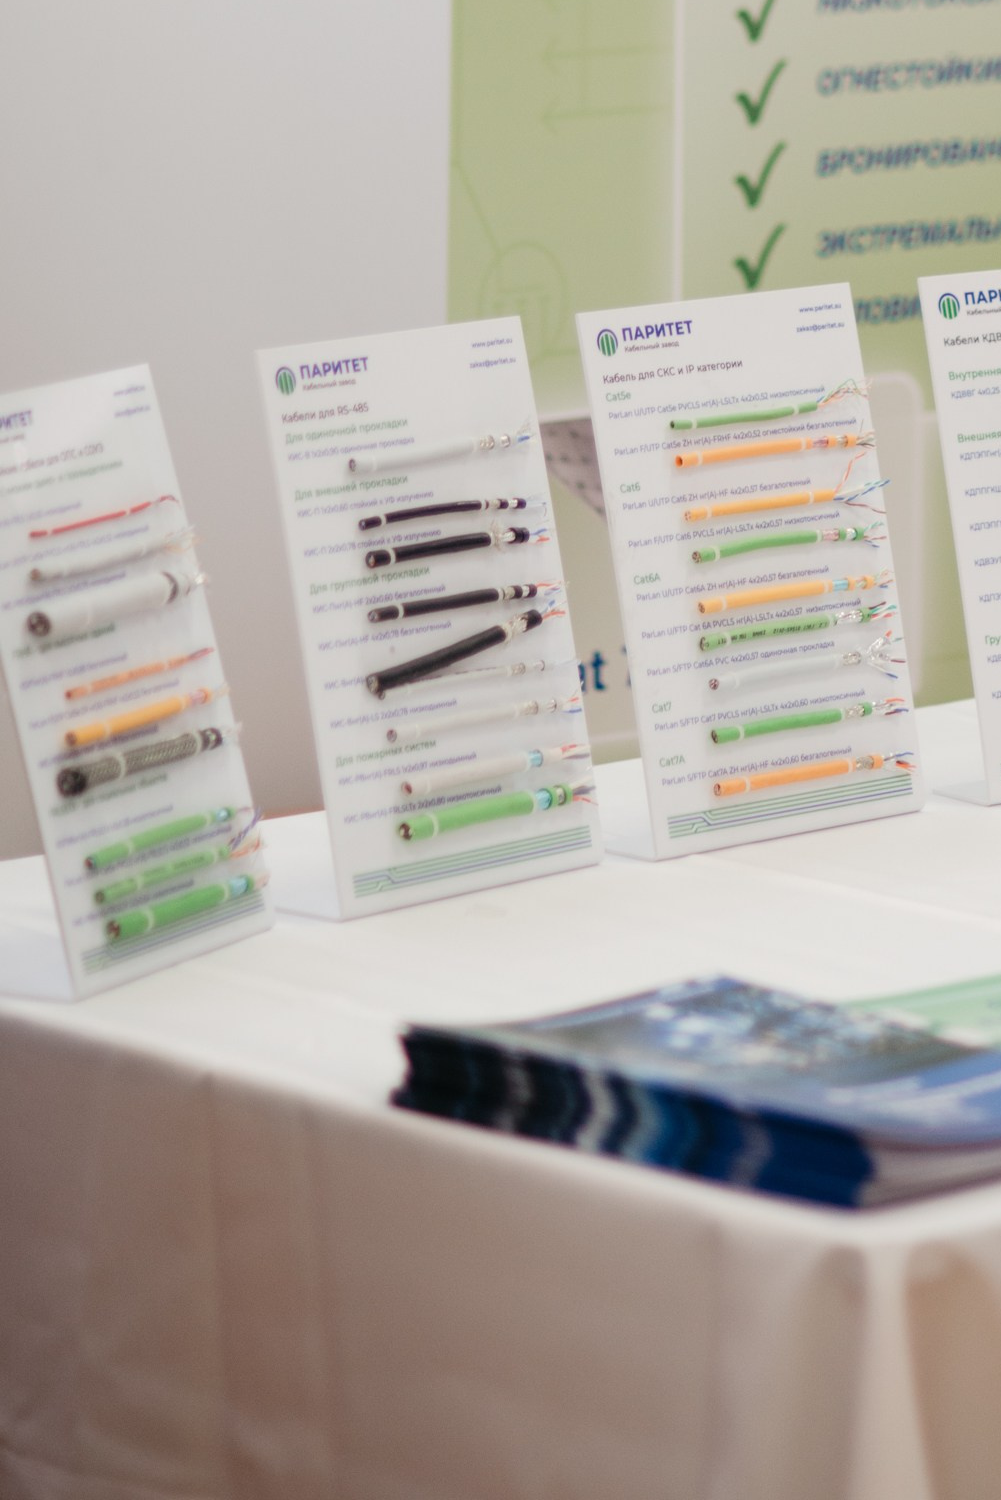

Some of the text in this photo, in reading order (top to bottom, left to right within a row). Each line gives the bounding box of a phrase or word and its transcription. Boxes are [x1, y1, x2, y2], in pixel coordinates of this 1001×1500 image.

[798, 302, 842, 315] www.paritet.su
[622, 320, 693, 342] ПАРИТЕТ
[796, 321, 845, 335] zakaz@paritet.su
[943, 332, 979, 347] Кабели
[624, 341, 680, 353] Кабельный завод
[300, 358, 369, 380] ПАРИТЕТ
[602, 359, 743, 385] Кабель для СКС и IP категории
[605, 389, 632, 402] Cat5e
[957, 428, 1001, 443] Внешняя
[620, 480, 641, 493] Cat6
[634, 571, 661, 585] Cat6A
[652, 700, 672, 714] Cat7
[659, 753, 685, 767] Cat7A
